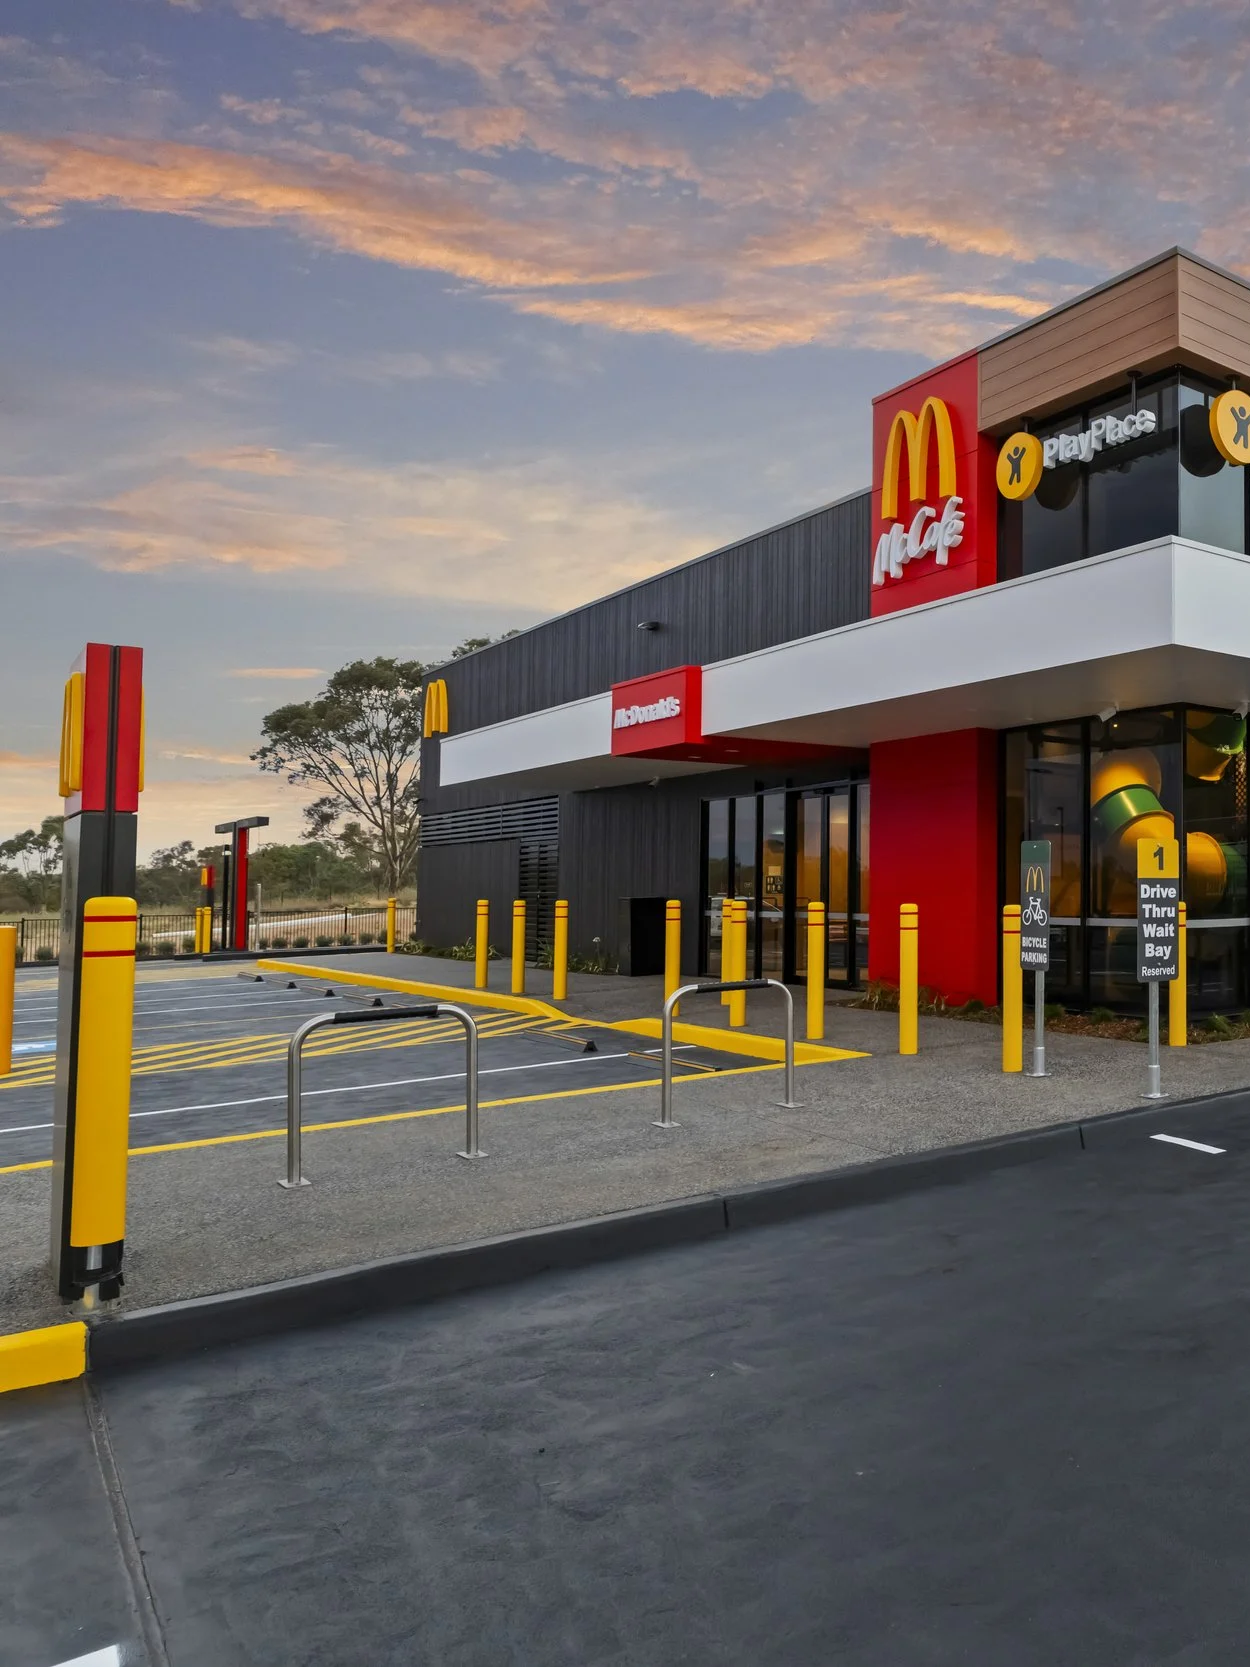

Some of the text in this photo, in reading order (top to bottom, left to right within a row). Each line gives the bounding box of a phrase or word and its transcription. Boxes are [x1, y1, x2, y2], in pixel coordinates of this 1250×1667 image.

[1043, 409, 1157, 469] PlayPlace
[872, 496, 966, 586] McCafé
[1153, 846, 1165, 871] 1
[1140, 884, 1177, 899] Drive
[1142, 904, 1176, 918] Thru
[1142, 923, 1175, 938] Wait
[1022, 936, 1047, 949] BICYCLE
[1021, 951, 1048, 964] PARKING
[1145, 943, 1172, 960] Bay
[1141, 965, 1176, 977] Reserved
